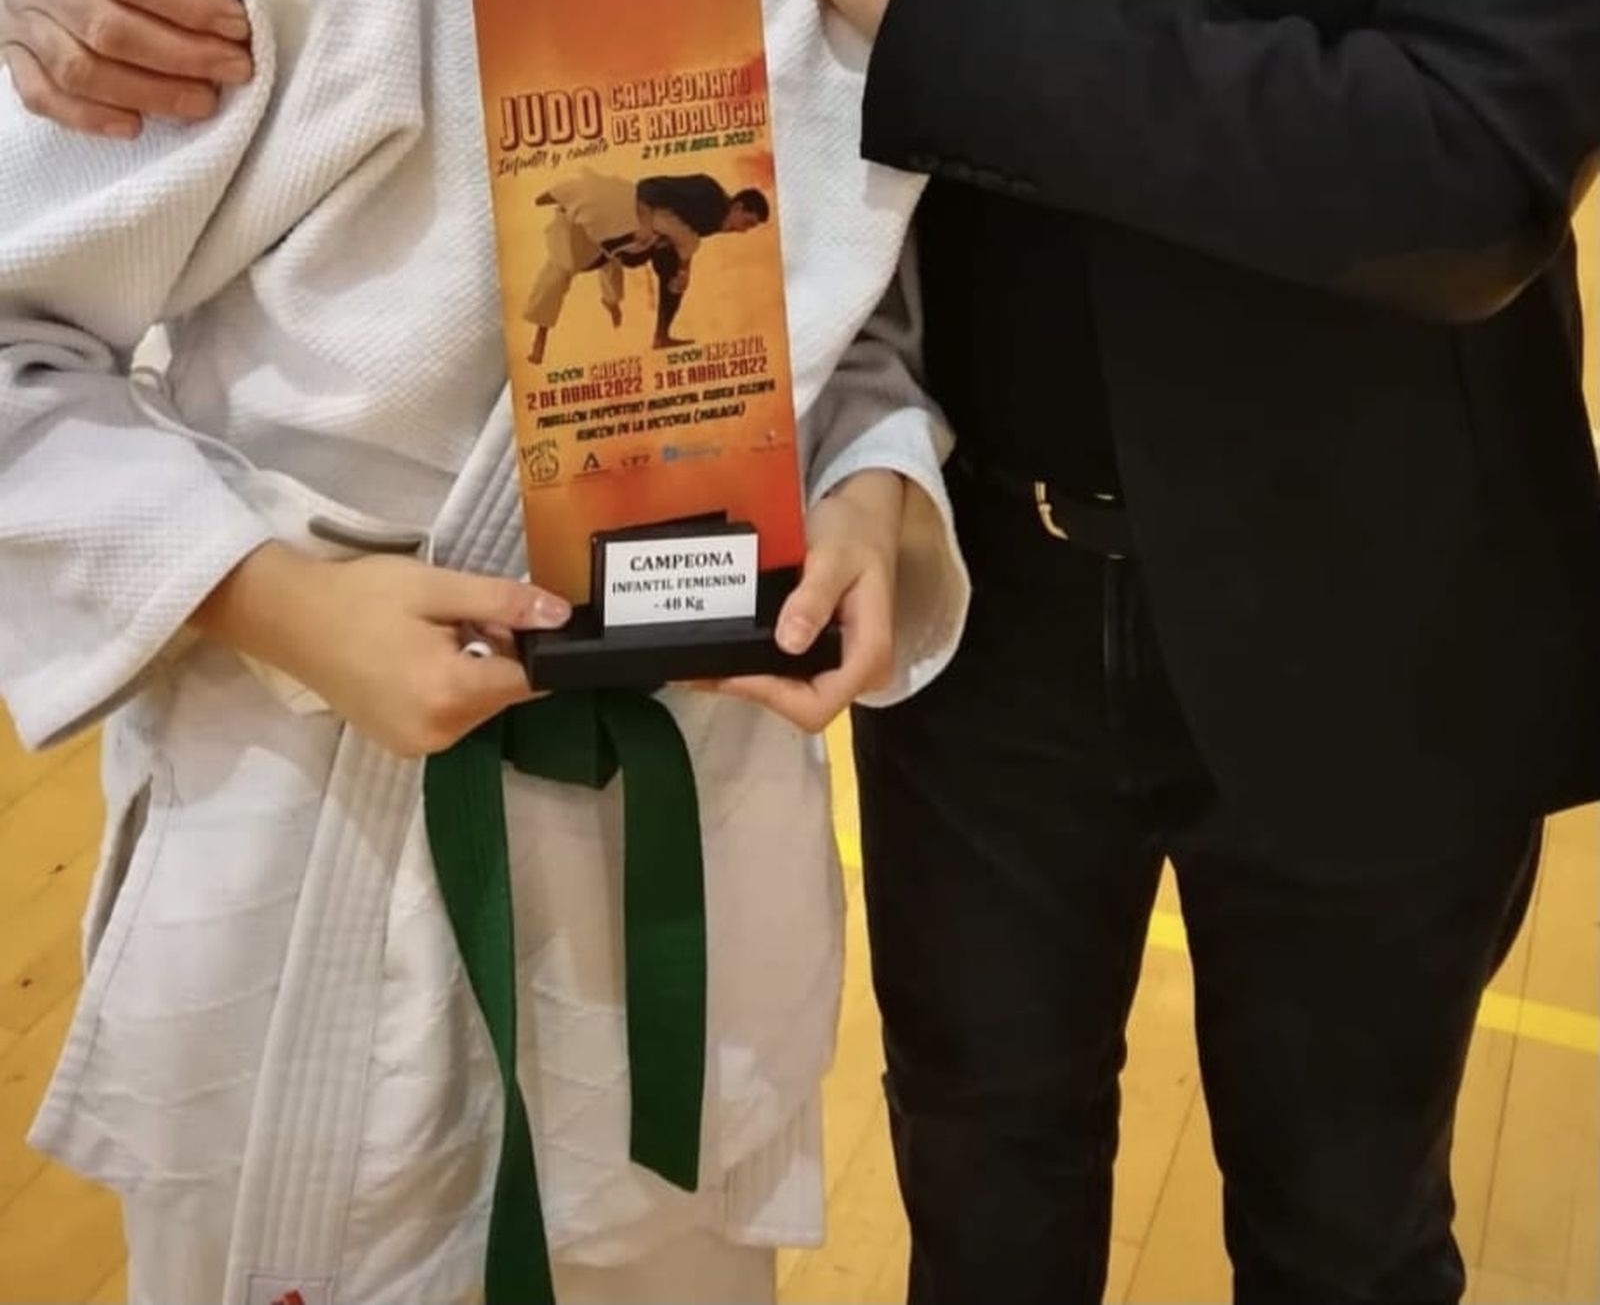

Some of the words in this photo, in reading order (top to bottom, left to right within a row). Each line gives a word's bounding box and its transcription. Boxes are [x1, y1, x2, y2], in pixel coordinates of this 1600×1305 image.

[500, 86, 605, 152] JUDO
[608, 67, 754, 111] CAMPEONATO
[611, 112, 641, 145] DE
[655, 371, 664, 390] 3
[667, 368, 685, 389] DE
[729, 355, 768, 377] 2022
[528, 393, 537, 411] 2
[540, 390, 557, 409] DE
[604, 376, 642, 399] 2022
[630, 551, 734, 572] CAMPEONA
[612, 579, 674, 594] INFANTIL
[677, 574, 746, 590] FEMENINO
[685, 597, 704, 611] Kg
